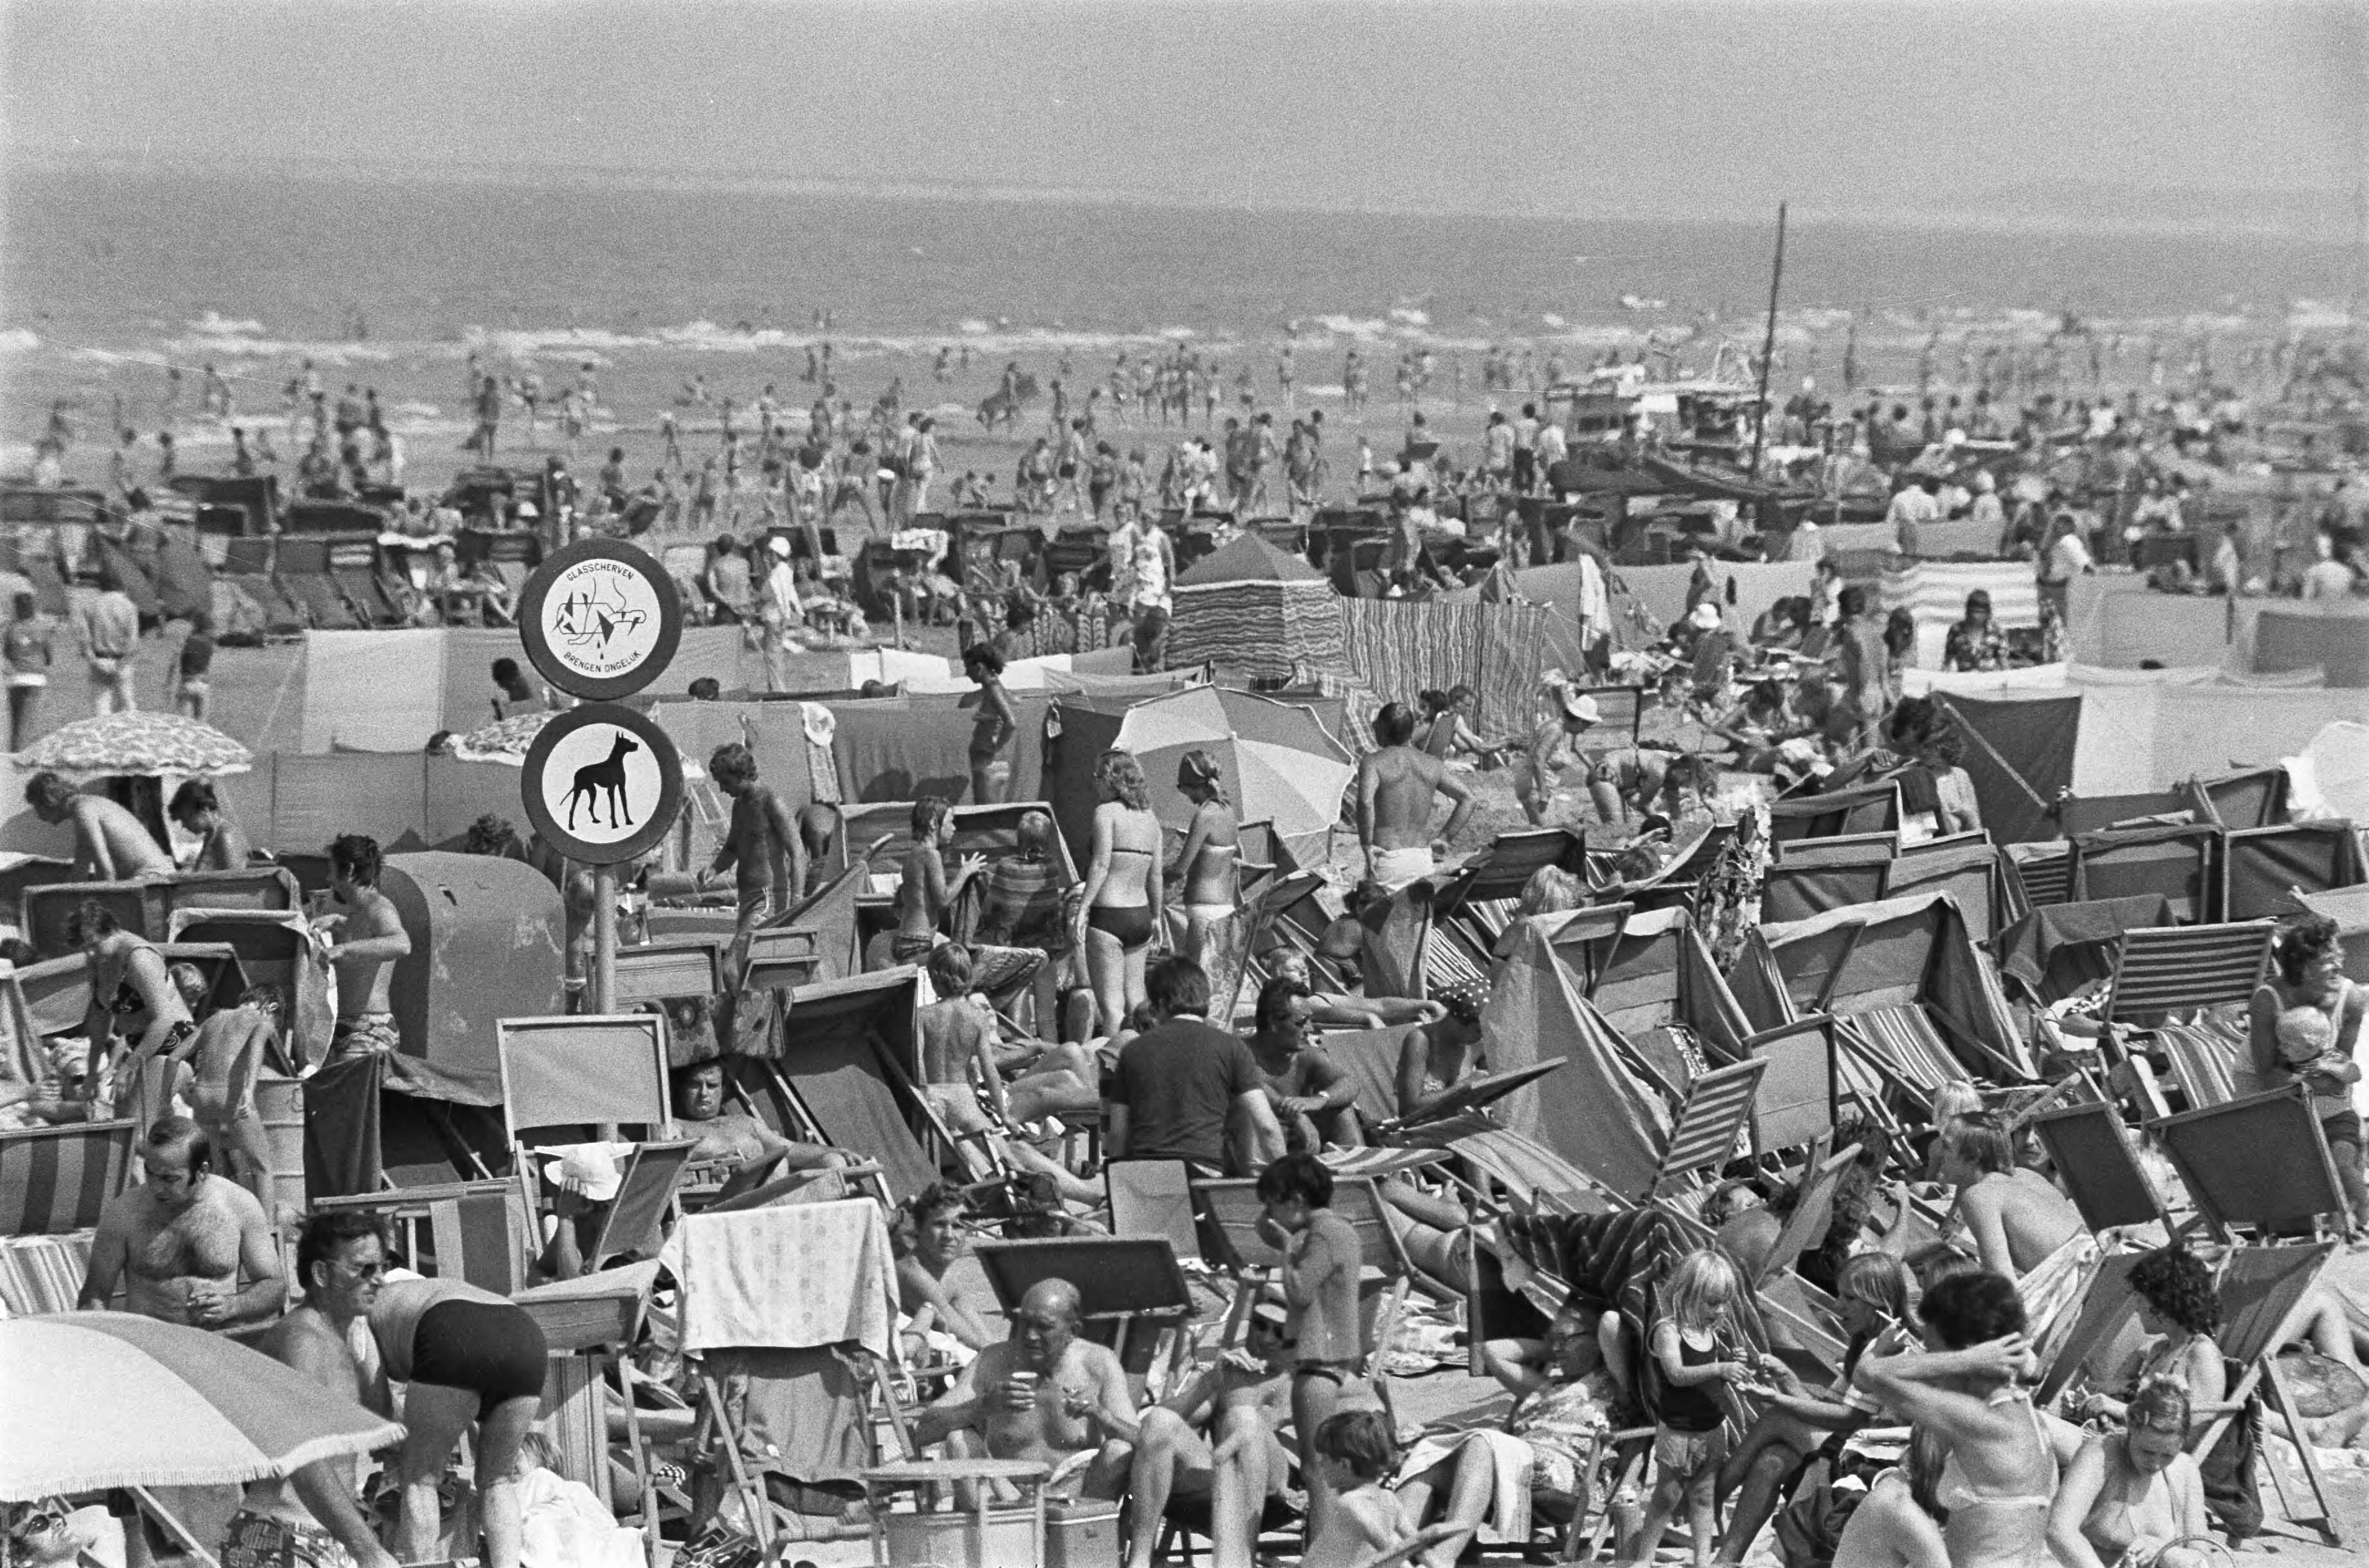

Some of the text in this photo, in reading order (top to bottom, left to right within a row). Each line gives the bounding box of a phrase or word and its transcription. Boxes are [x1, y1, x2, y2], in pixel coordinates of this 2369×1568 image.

[567, 563, 634, 581] GLASSCHERVEN
[564, 651, 641, 672] BRENGEN ONGELUK
